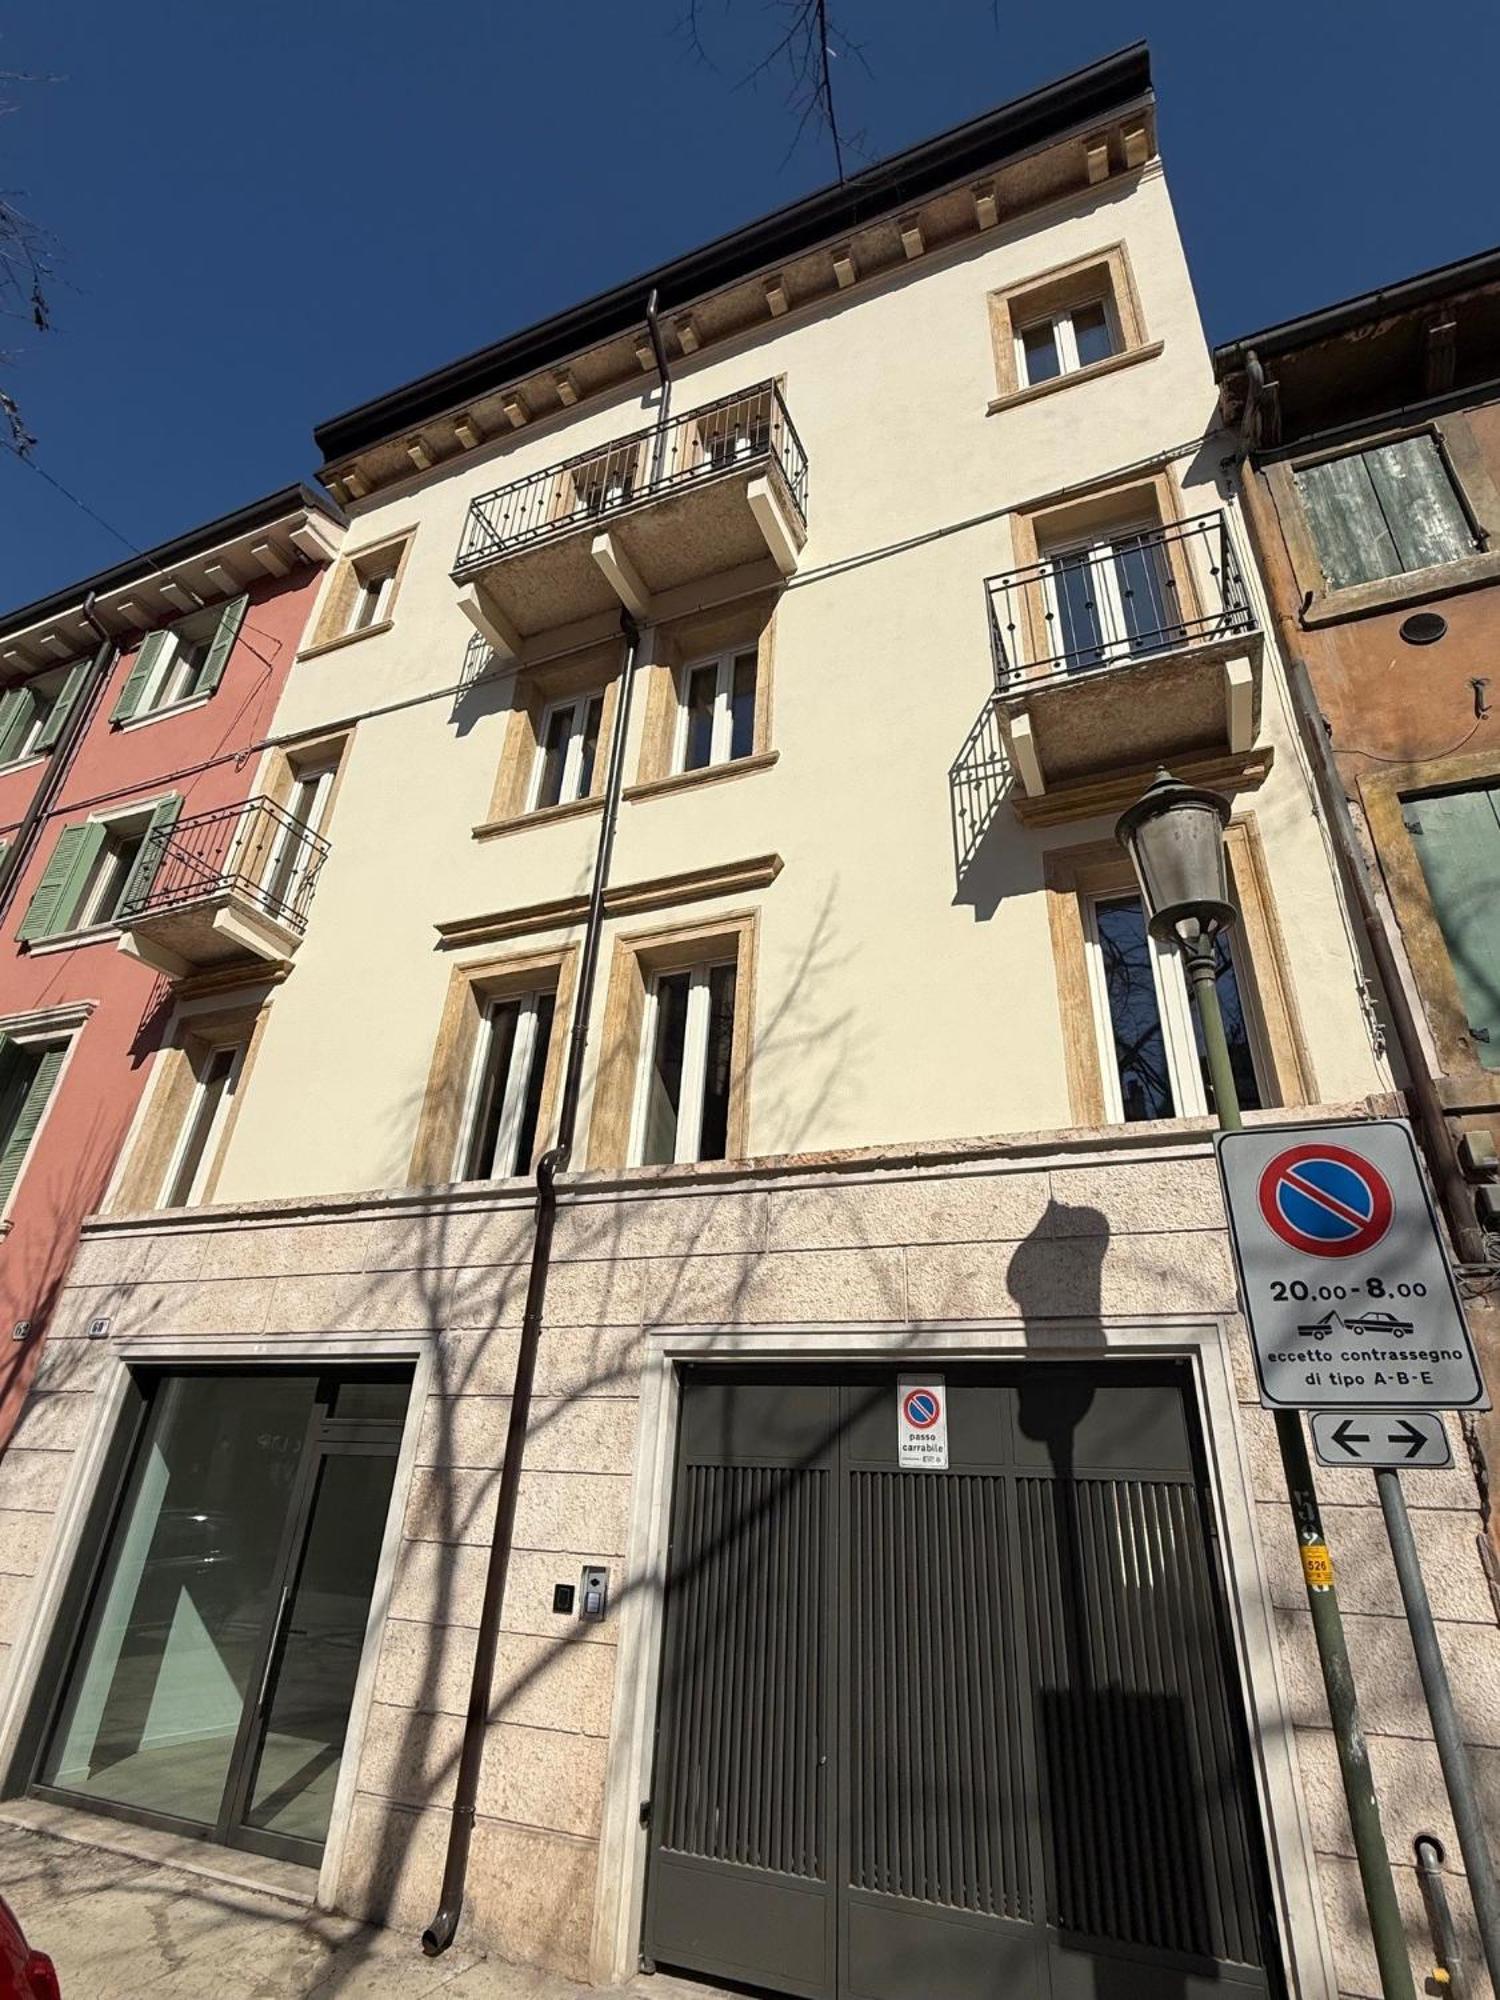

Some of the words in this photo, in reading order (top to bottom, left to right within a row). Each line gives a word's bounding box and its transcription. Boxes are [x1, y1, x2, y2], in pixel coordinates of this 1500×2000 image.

[1267, 1349, 1333, 1363] eccetto
[1340, 1348, 1464, 1364] contrassegno
[1305, 1372, 1322, 1386] di
[1329, 1372, 1365, 1388] tipo
[909, 1434, 936, 1442] passo
[902, 1444, 944, 1453] carrabile
[1307, 1560, 1327, 1571] 526
